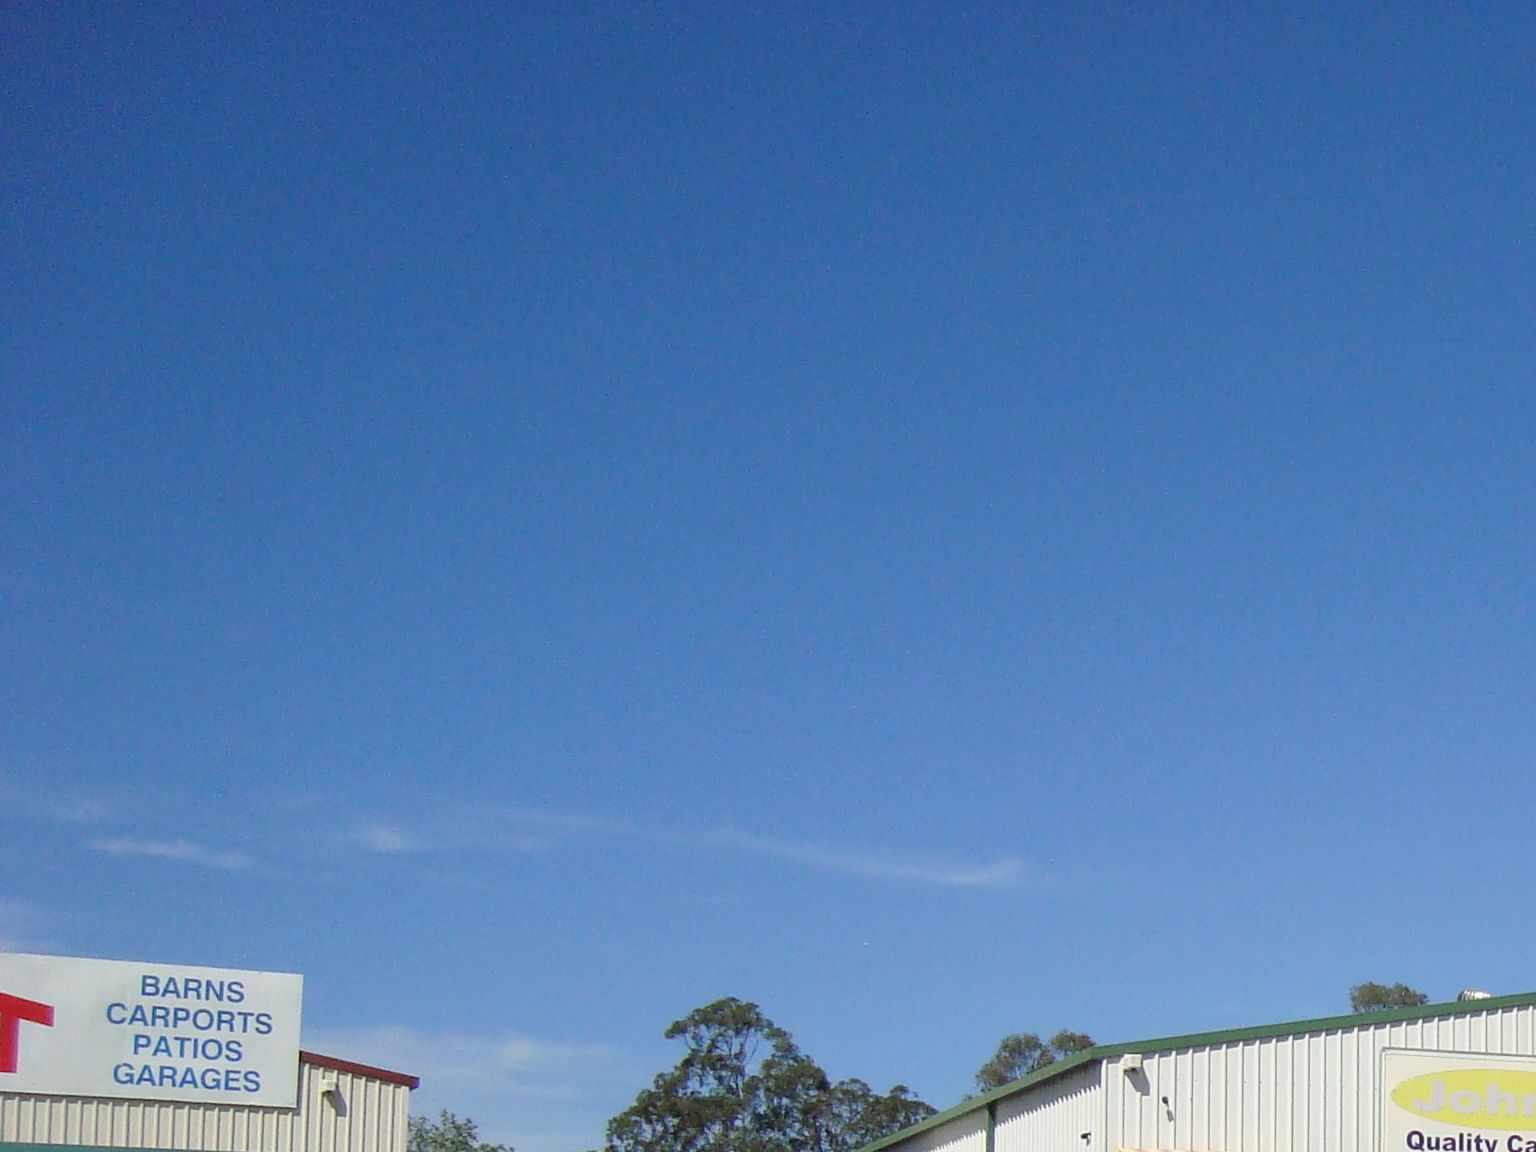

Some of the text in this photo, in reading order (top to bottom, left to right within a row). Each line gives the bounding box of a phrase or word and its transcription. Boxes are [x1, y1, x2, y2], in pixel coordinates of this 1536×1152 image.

[140, 974, 245, 1003] BARNS
[107, 1002, 273, 1035] CARPORTS
[133, 1034, 243, 1062] PATIOS
[113, 1063, 261, 1093] GARAGES
